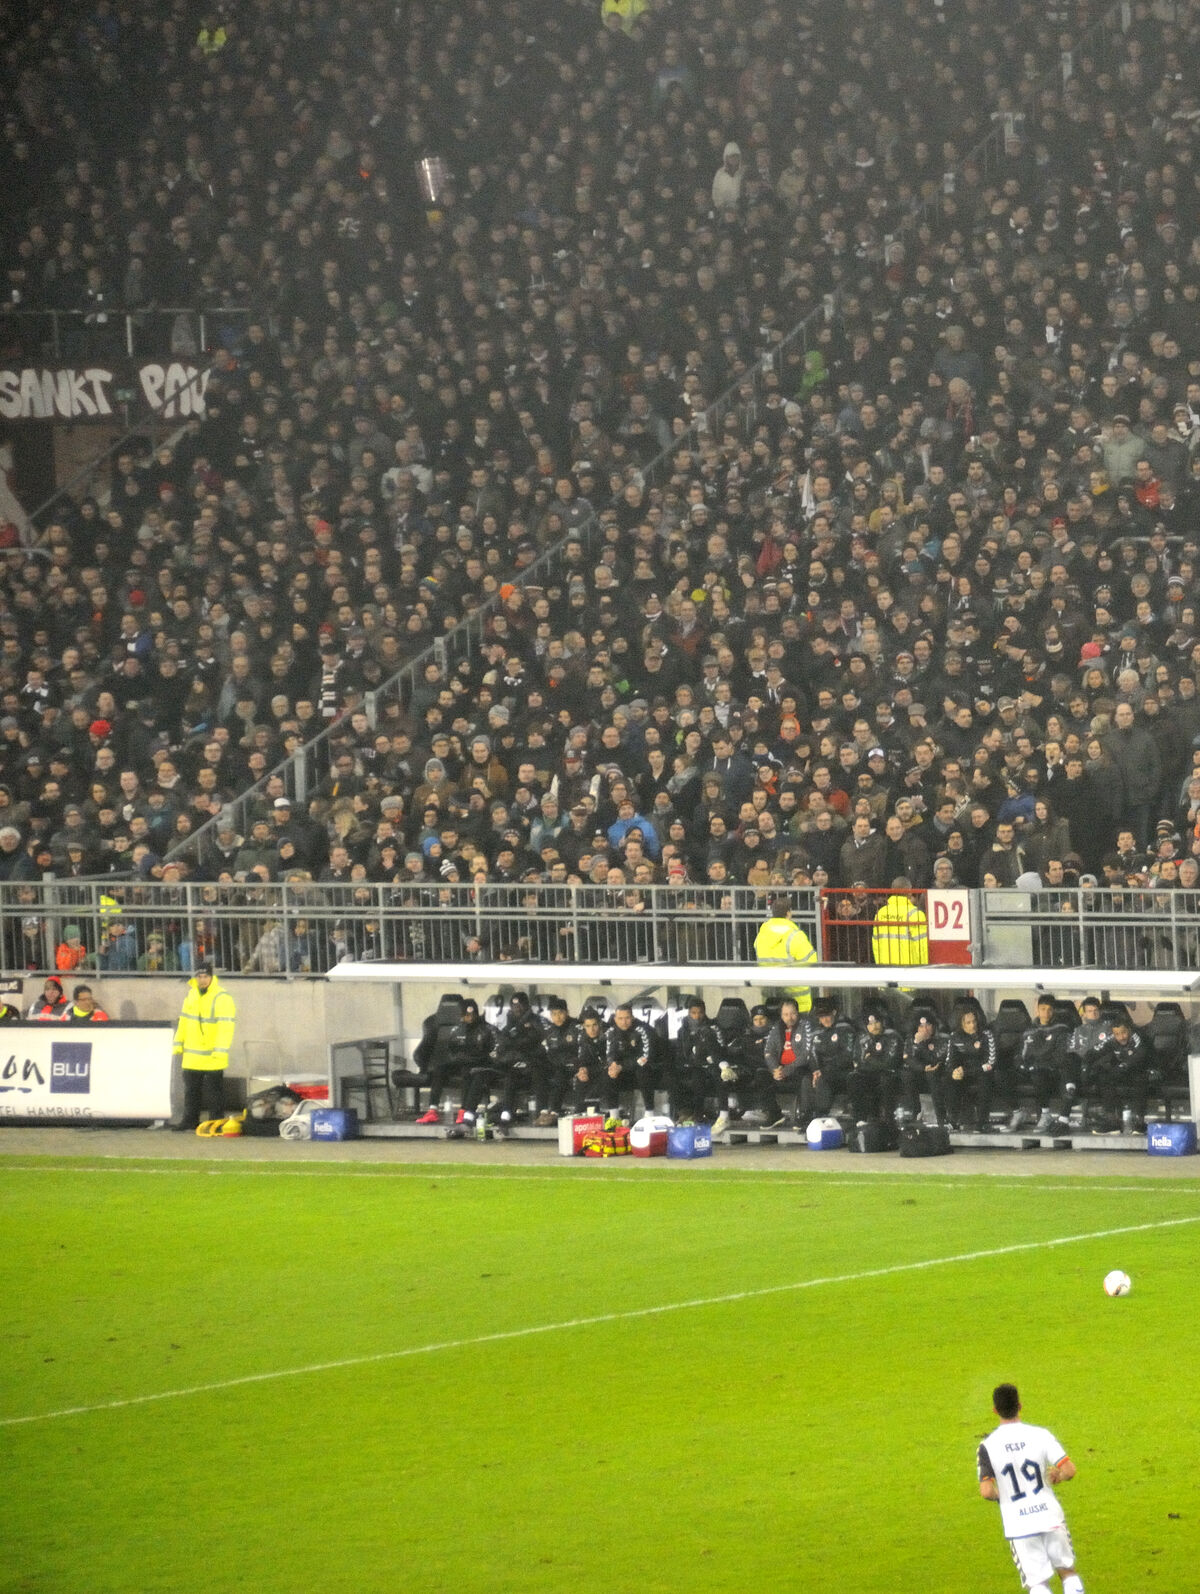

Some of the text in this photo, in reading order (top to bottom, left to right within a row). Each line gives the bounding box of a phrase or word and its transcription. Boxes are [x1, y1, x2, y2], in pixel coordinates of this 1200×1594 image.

[0, 368, 113, 418] SANKT
[933, 900, 964, 930] D2
[53, 1063, 89, 1077] BLU
[27, 1107, 93, 1118] HAMBURG
[1152, 1135, 1172, 1148] hella
[1001, 1458, 1044, 1502] 19
